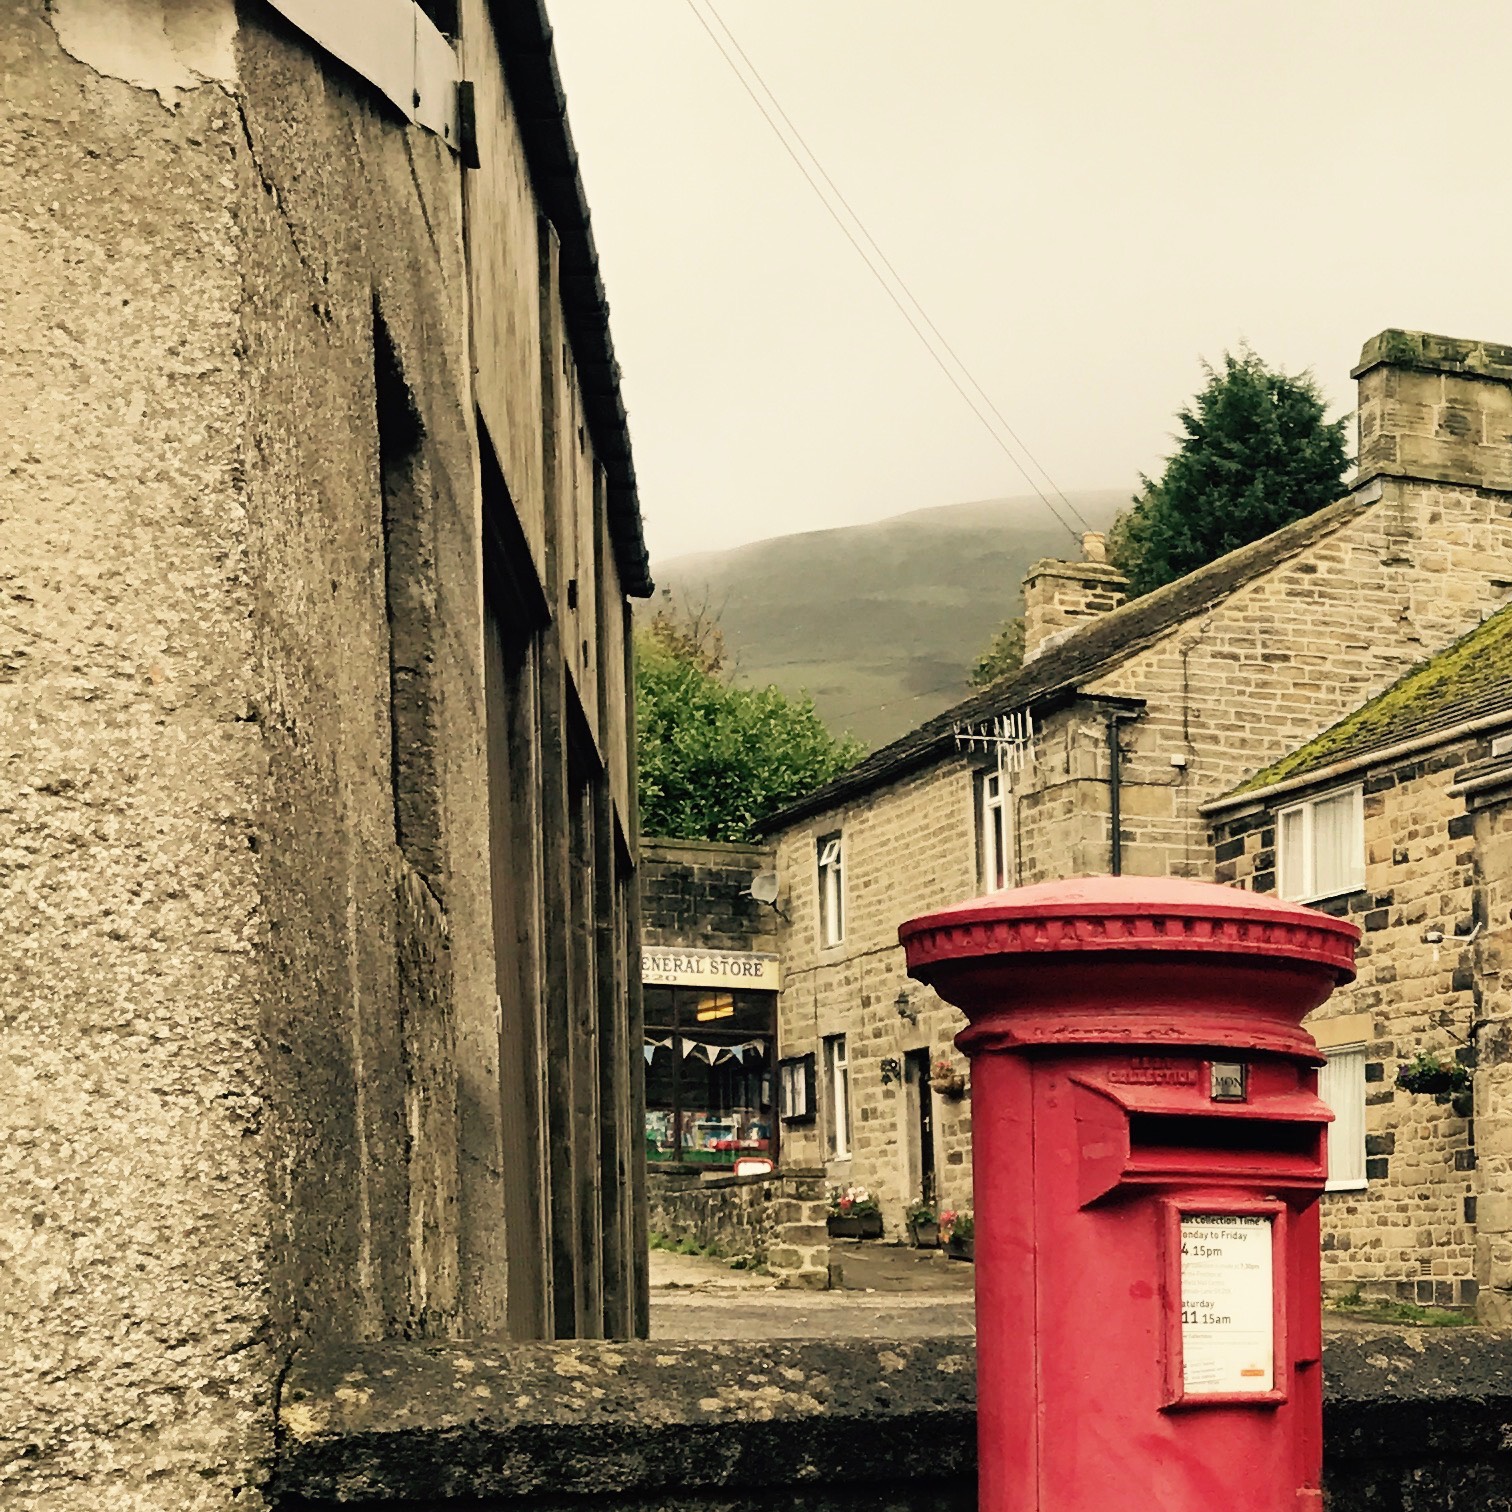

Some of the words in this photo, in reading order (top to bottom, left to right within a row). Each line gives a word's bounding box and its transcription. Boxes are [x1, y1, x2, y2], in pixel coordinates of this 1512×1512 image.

[642, 956, 705, 974] ENERAL
[710, 960, 764, 977] STORE
[1215, 1076, 1242, 1088] MON
[1182, 1230, 1209, 1241] onday
[1211, 1231, 1220, 1239] to
[1221, 1230, 1248, 1242] Friday
[1182, 1300, 1215, 1310] aturday
